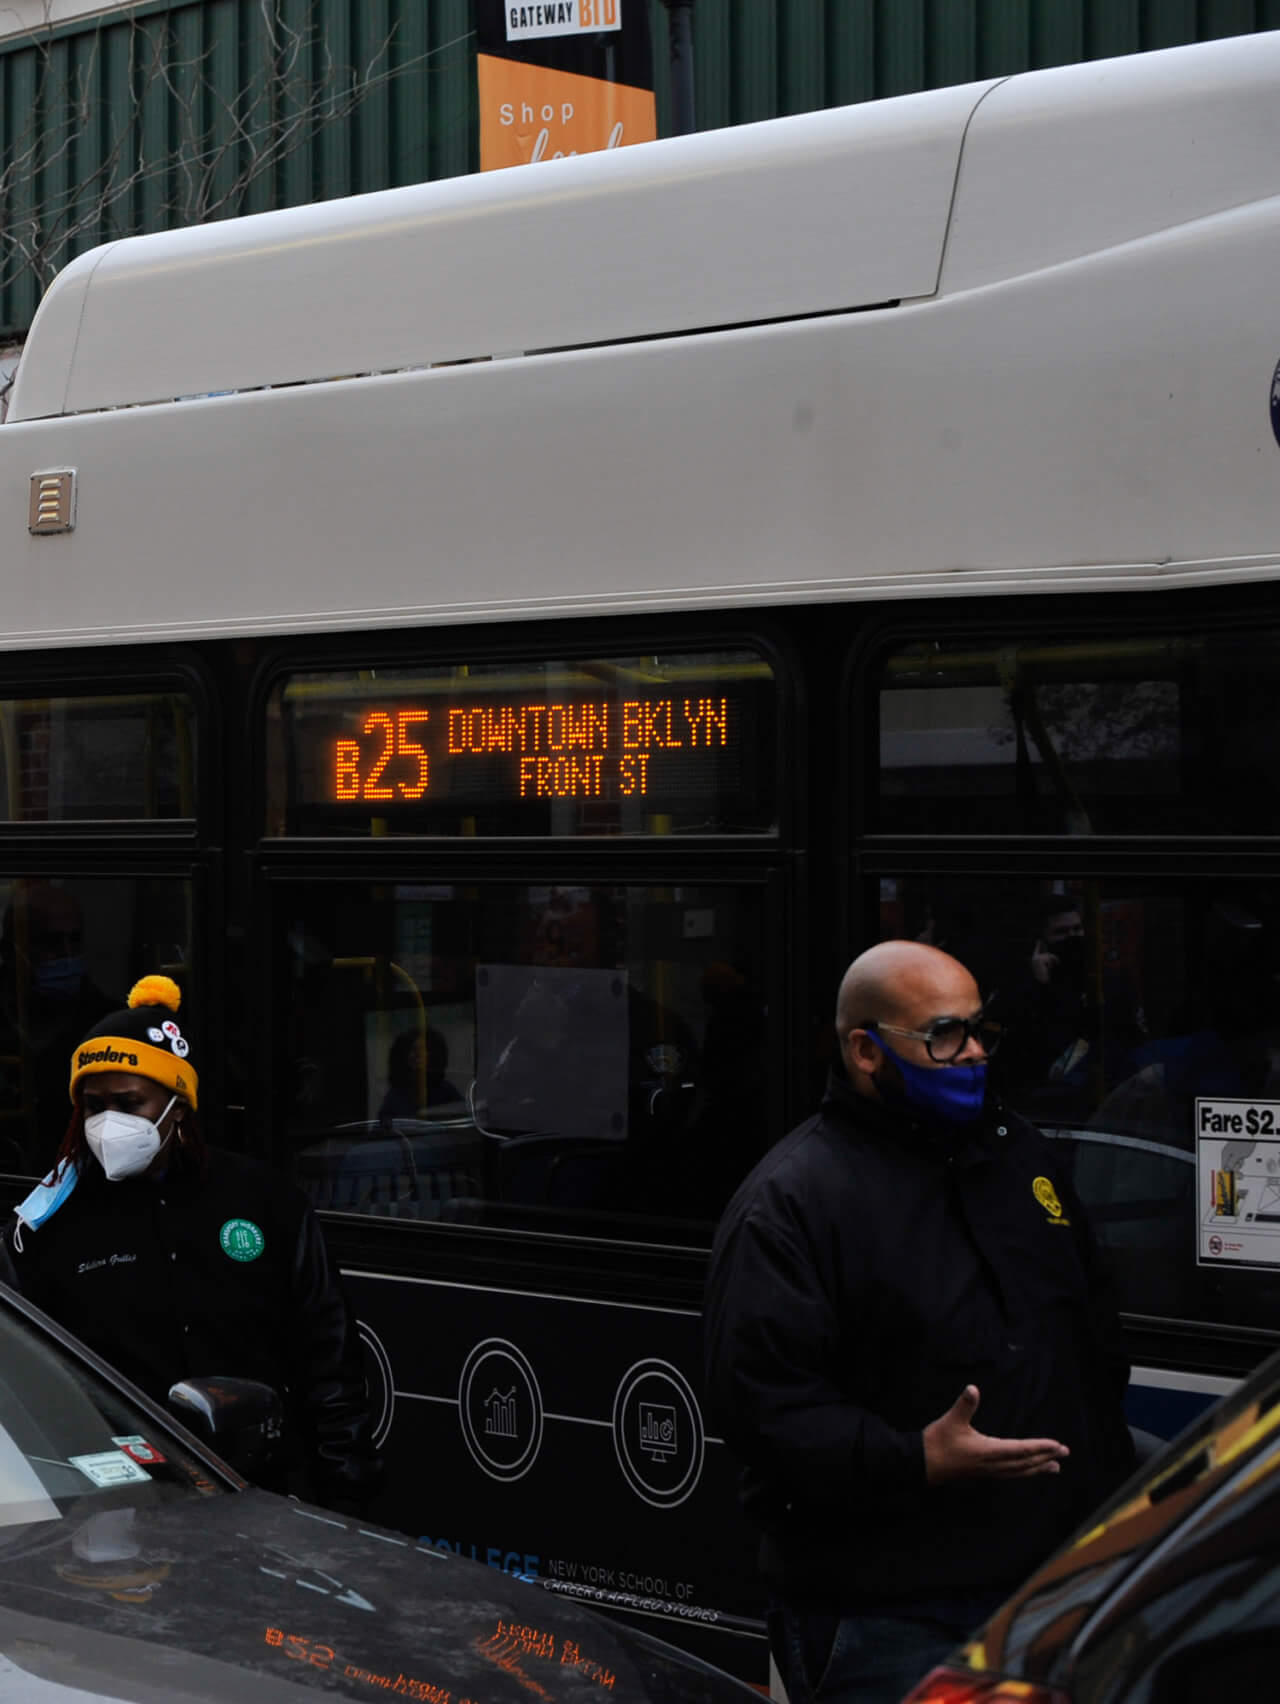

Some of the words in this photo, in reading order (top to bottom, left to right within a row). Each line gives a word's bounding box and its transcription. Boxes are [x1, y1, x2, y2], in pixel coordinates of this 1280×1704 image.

[510, 3, 573, 28] GATEWAY
[579, 0, 617, 27] BID
[499, 102, 574, 125] Shop
[336, 711, 429, 799] B25
[448, 703, 608, 754] DOWNTOWN
[623, 698, 727, 749] BKLYN
[520, 755, 604, 796] FRONT
[619, 754, 650, 795] ST
[78, 1045, 138, 1069] Steelers
[1201, 1107, 1243, 1133] Fare
[549, 1560, 577, 1577] NEW
[581, 1565, 615, 1585] YORK
[619, 1572, 671, 1597] SCHOOL
[675, 1582, 694, 1599] OF
